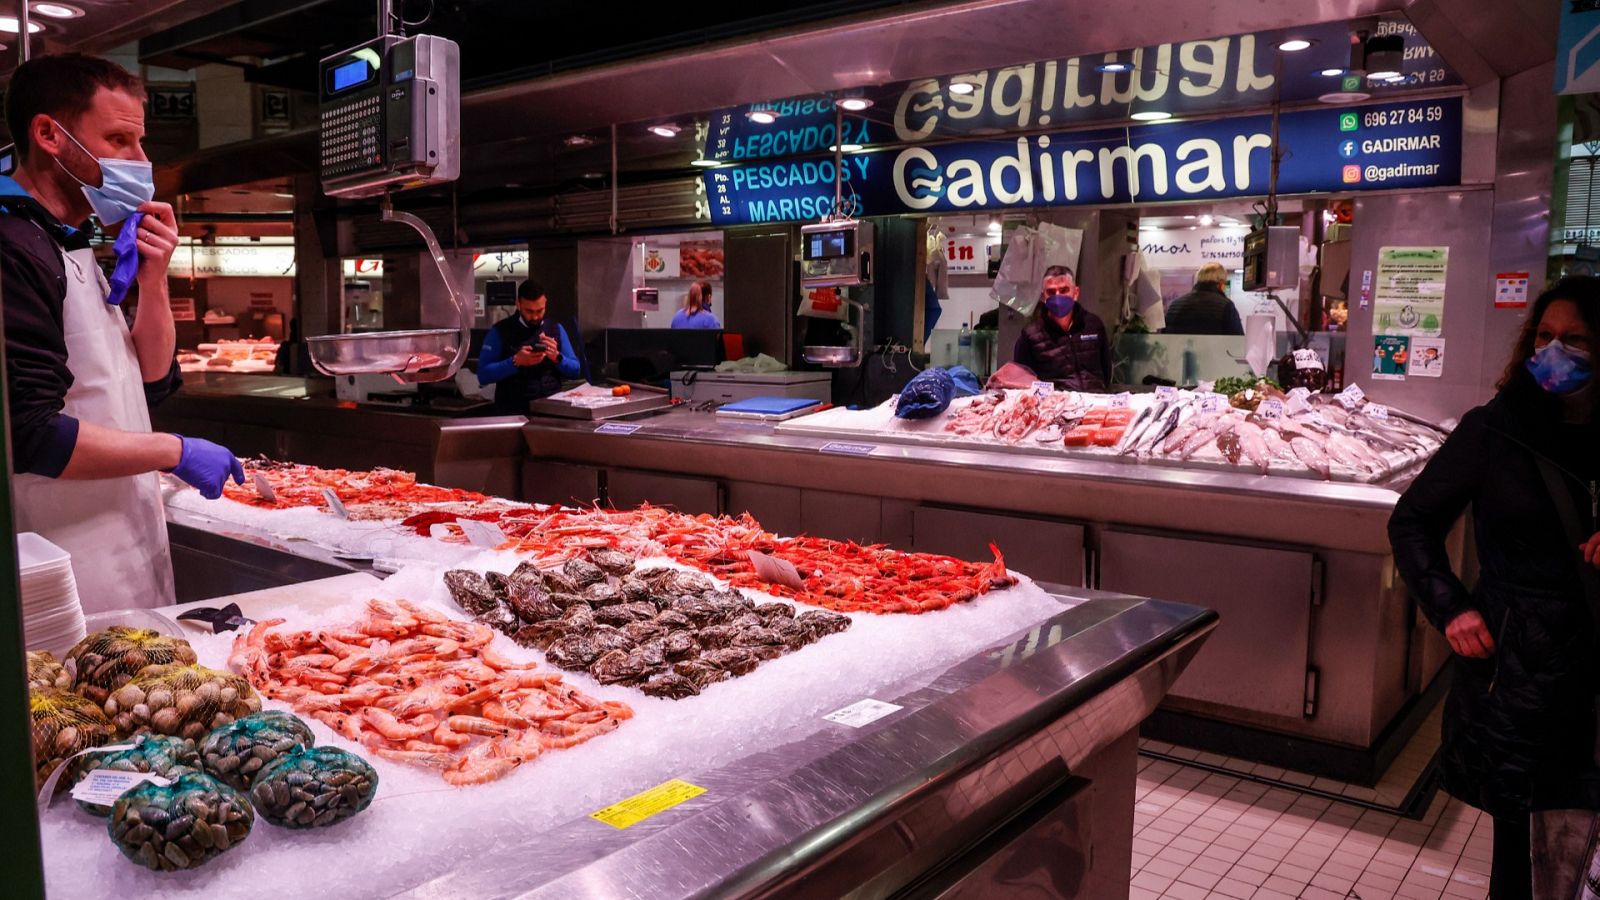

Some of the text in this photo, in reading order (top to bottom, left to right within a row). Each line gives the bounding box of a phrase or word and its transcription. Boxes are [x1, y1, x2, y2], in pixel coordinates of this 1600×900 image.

[1364, 105, 1443, 127] 696 27 84 59
[1362, 134, 1441, 154] GADIRMAR
[732, 156, 870, 191] PESCADOS Y
[893, 133, 1272, 209] Gadirmar
[1364, 163, 1440, 182] @gadirmar
[714, 173, 730, 182] Pto.
[717, 184, 726, 193] 28
[720, 196, 731, 204] AL
[722, 206, 731, 215] 32
[193, 248, 258, 256] PESCADOS
[197, 266, 258, 274] MARISCOS
